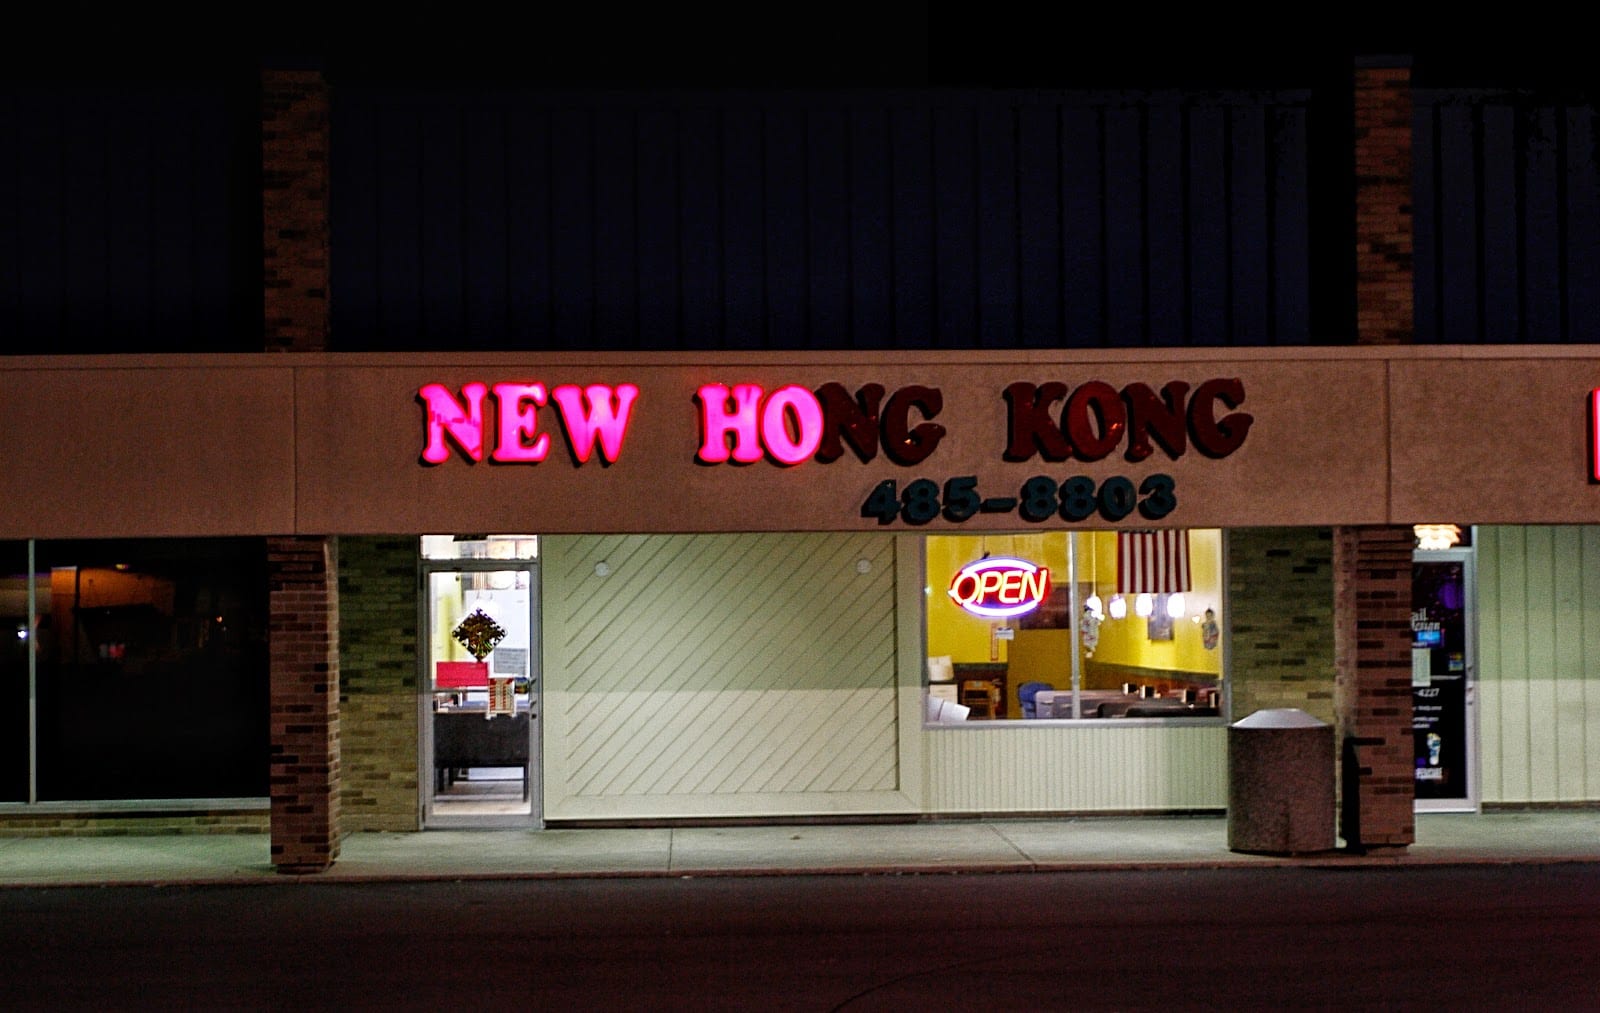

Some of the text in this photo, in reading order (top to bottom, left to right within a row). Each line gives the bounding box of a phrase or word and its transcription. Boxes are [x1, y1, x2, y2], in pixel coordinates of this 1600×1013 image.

[418, 377, 1253, 467] NEW HONG KONG
[861, 474, 1176, 526] 485-8803
[950, 568, 1048, 605] OPEN
